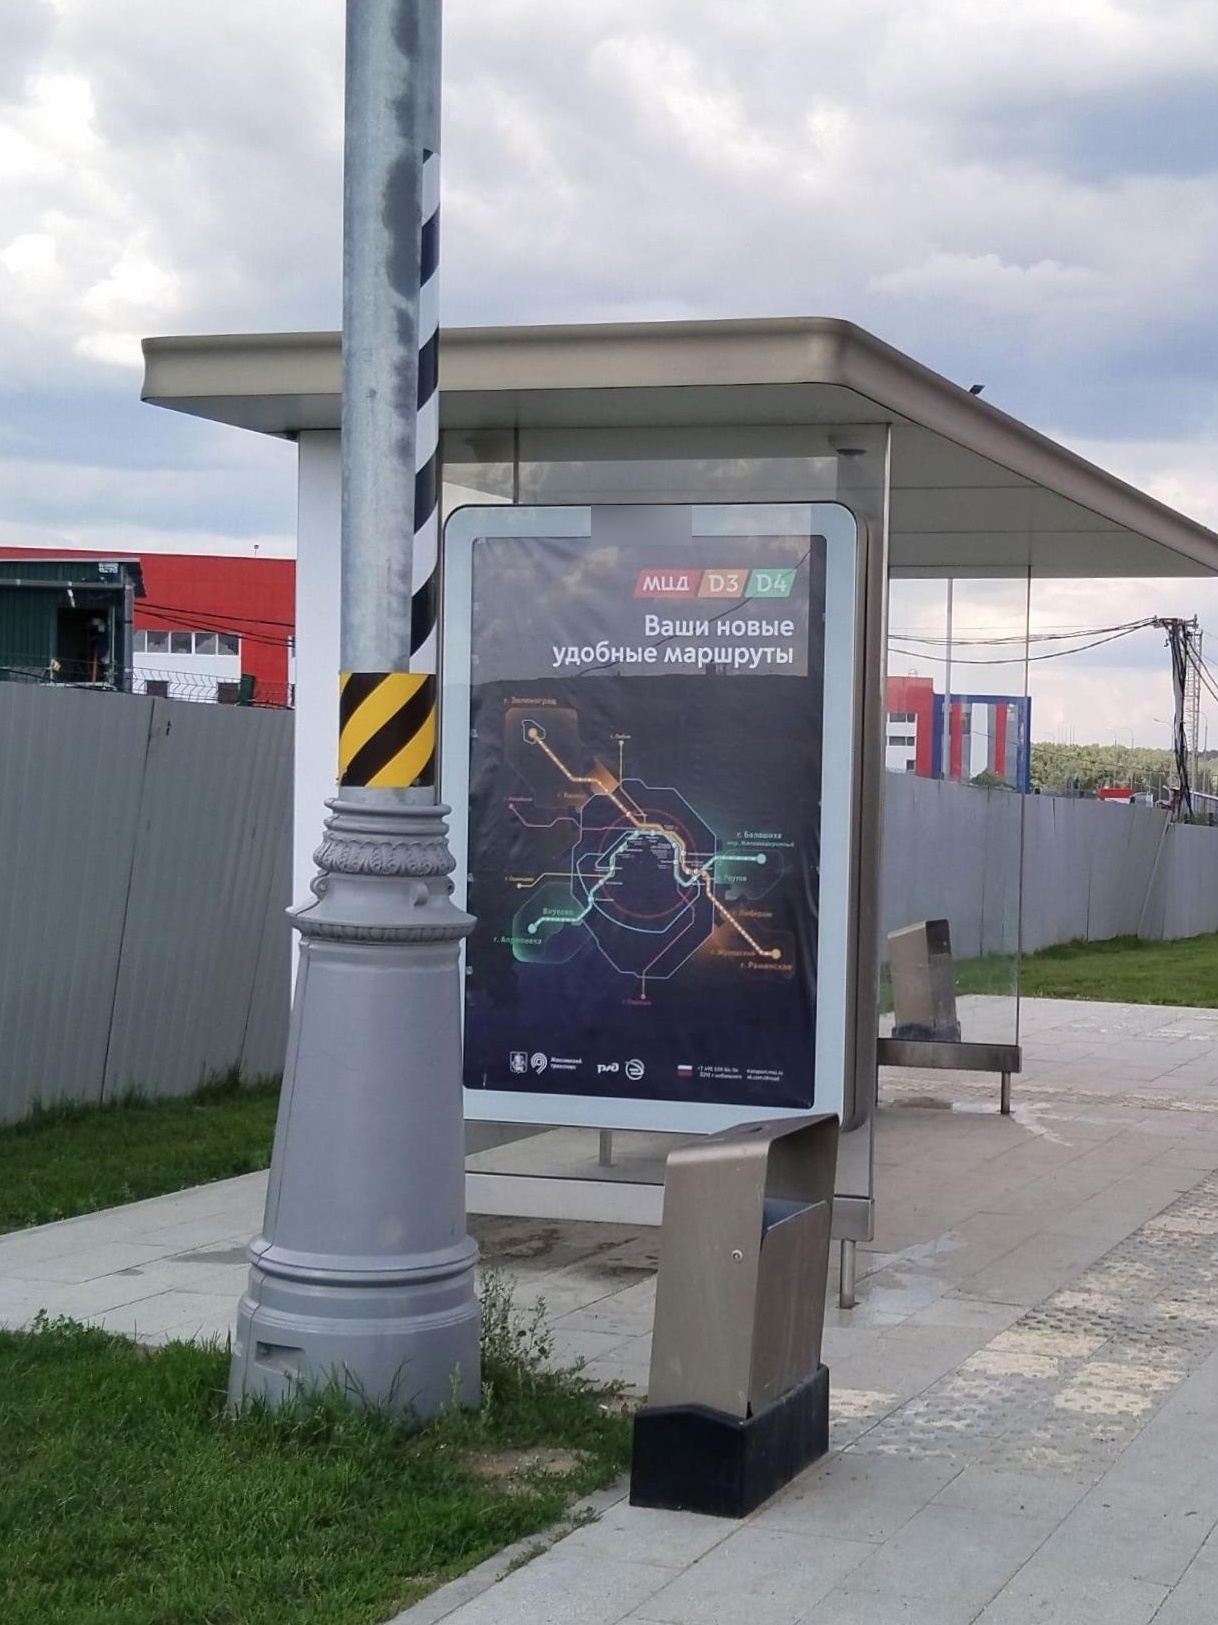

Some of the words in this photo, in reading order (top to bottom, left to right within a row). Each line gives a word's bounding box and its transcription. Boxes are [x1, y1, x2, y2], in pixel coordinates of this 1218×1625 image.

[642, 576, 690, 591] МЦД
[708, 574, 739, 592] D3
[755, 574, 786, 592] D4
[644, 614, 710, 637] Ваши
[717, 618, 795, 637] новые
[552, 640, 658, 668] удобные
[663, 646, 794, 669] маршруты
